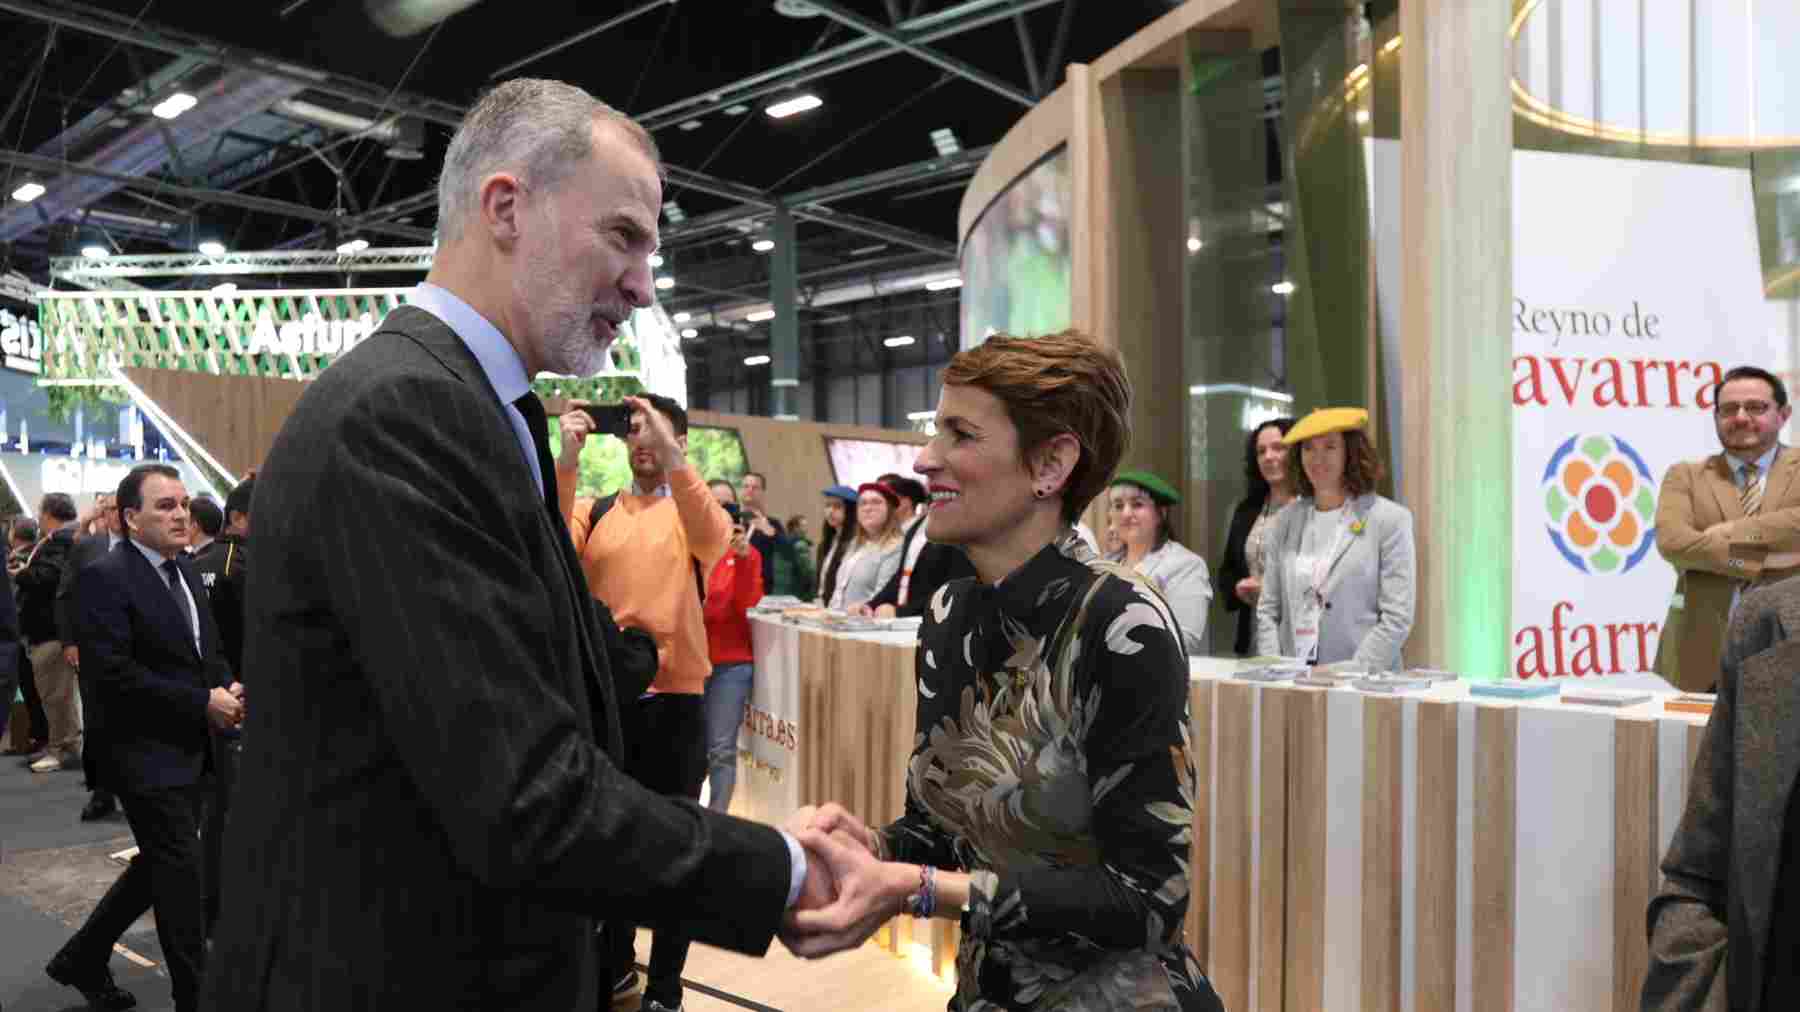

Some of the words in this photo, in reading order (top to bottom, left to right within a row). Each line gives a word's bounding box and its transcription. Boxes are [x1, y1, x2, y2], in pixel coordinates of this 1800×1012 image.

[1511, 296, 1611, 347] Reyno
[1623, 301, 1660, 340] de
[1511, 352, 1722, 410] avarra
[1514, 600, 1659, 680] afarr
[743, 703, 798, 751] arra.es
